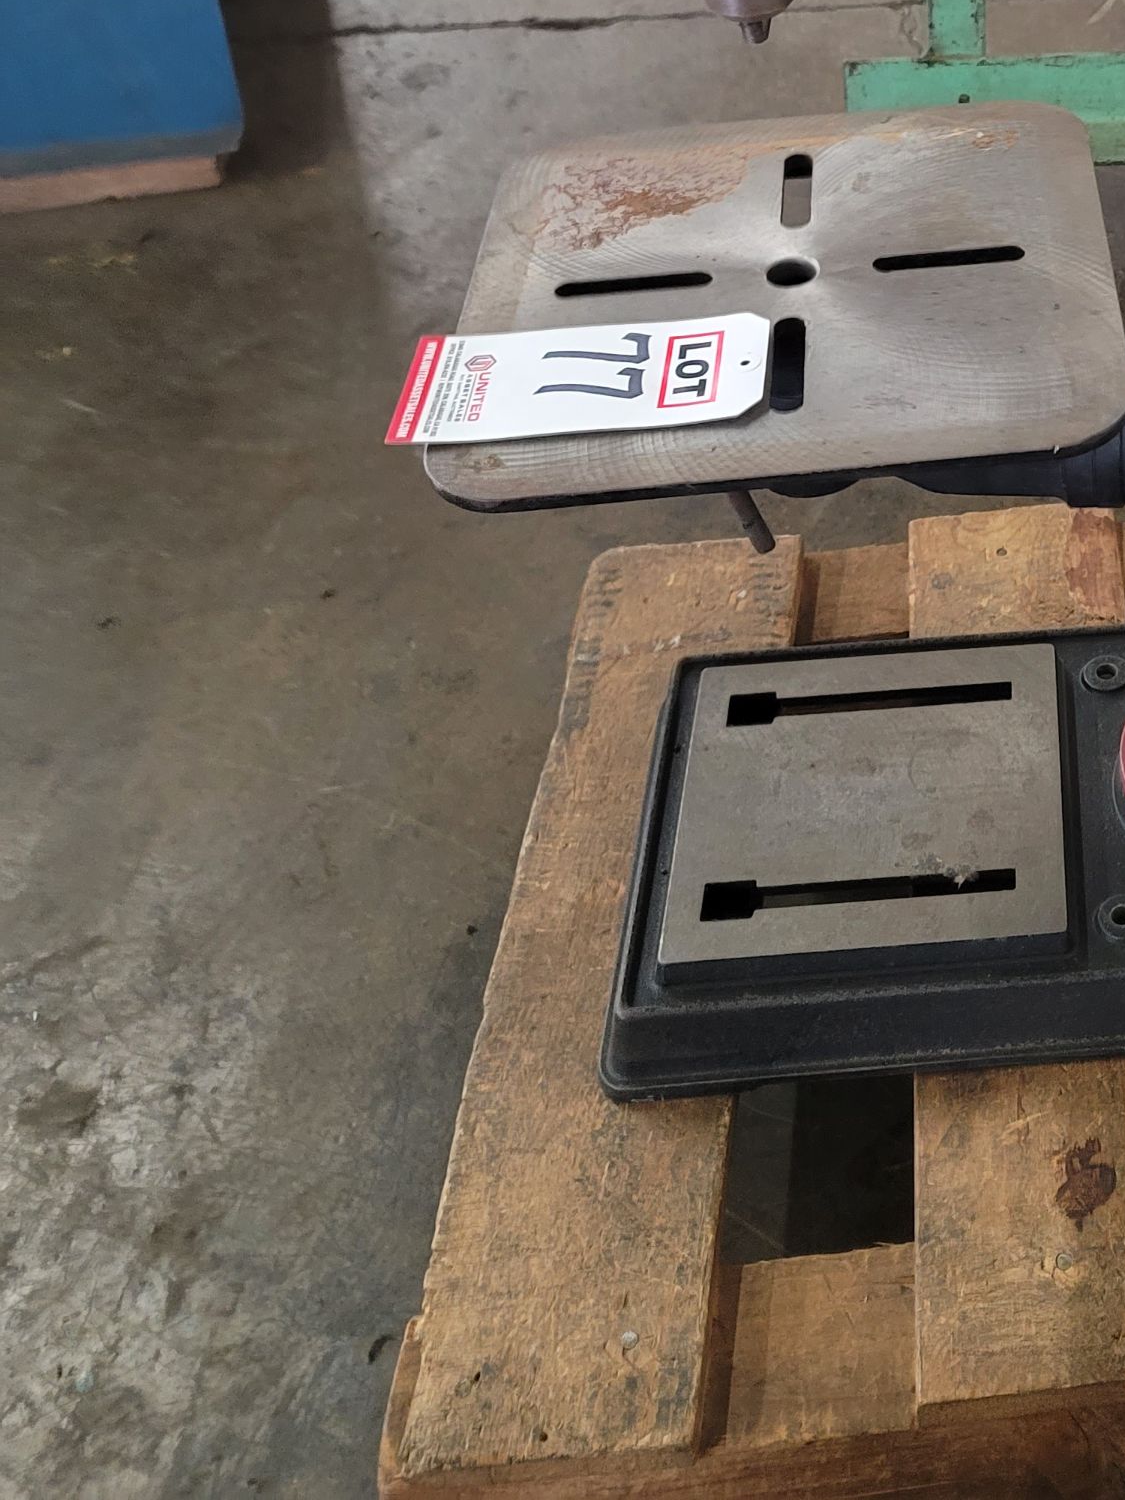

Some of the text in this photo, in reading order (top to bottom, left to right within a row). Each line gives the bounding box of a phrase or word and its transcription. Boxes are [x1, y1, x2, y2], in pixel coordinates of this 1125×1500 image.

[462, 374, 474, 397] ASSET
[533, 332, 653, 399] 77
[672, 341, 712, 397] LOT
[454, 398, 466, 422] SALES
[467, 372, 492, 421] UNITED
